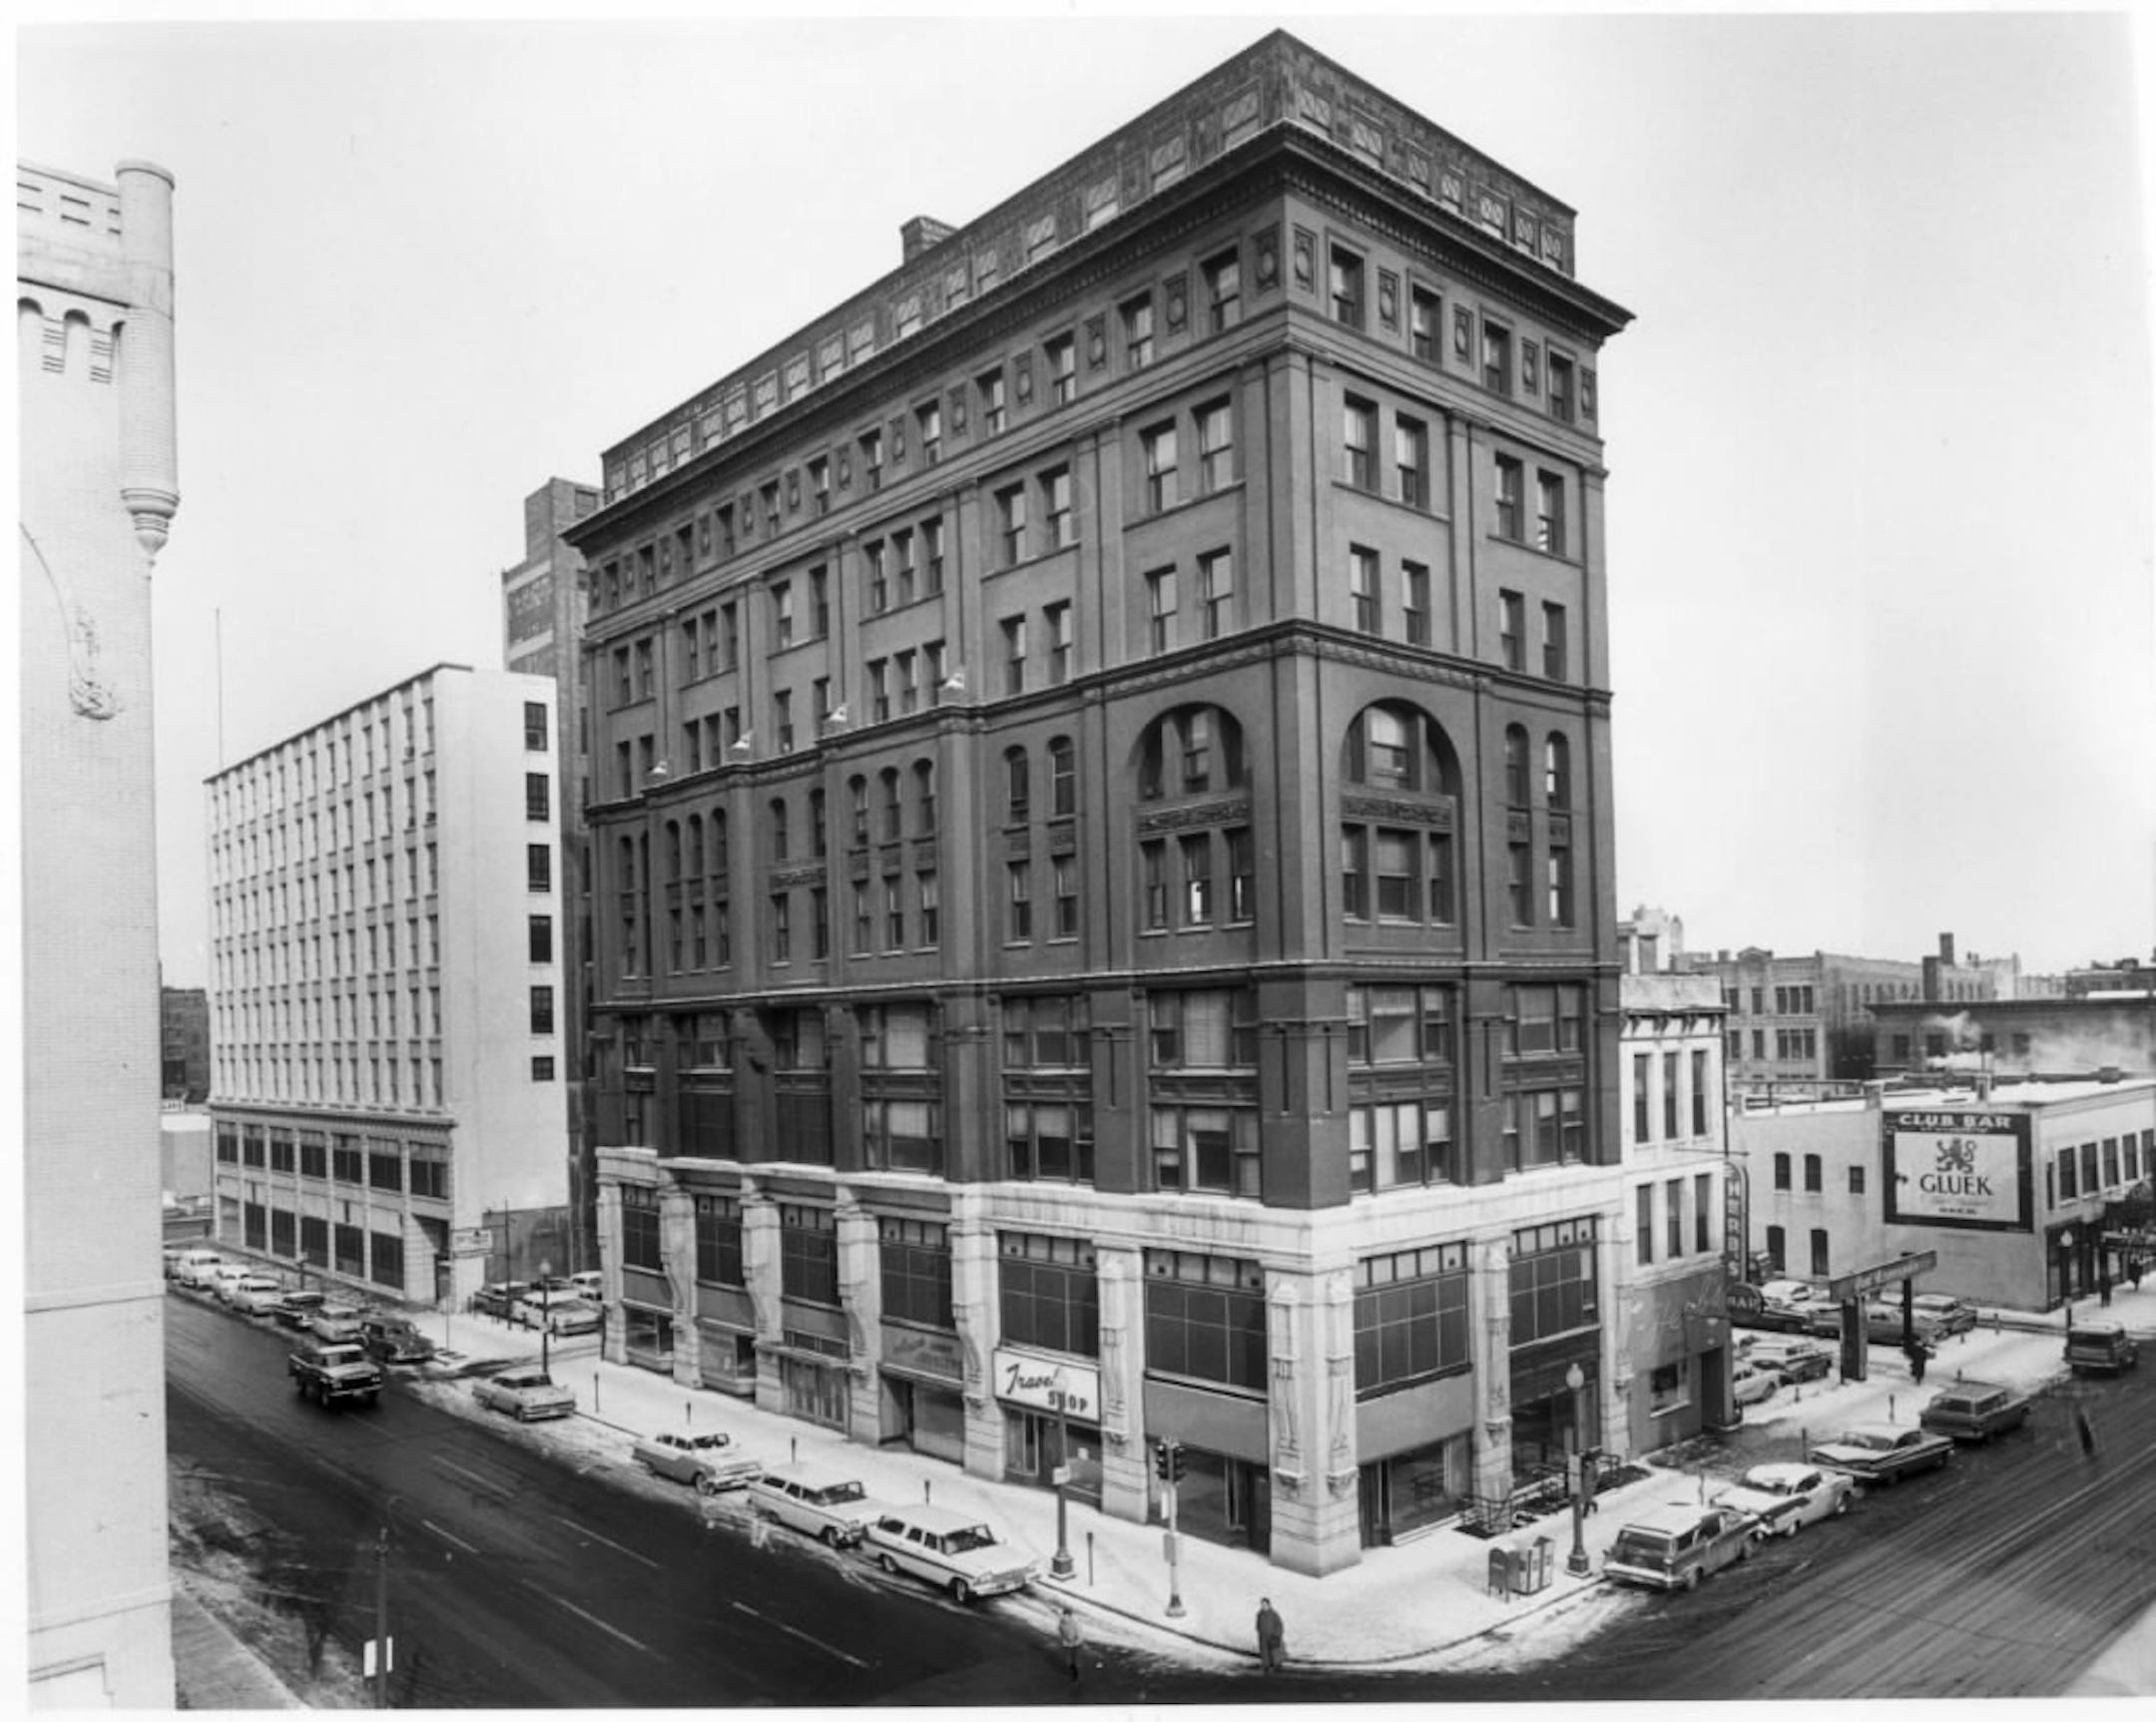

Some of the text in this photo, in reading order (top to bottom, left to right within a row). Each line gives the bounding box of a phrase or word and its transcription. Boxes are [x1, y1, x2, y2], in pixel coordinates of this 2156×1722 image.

[1898, 1113, 2012, 1129] CLUB BAR
[1919, 1173, 1994, 1197] GLUEK
